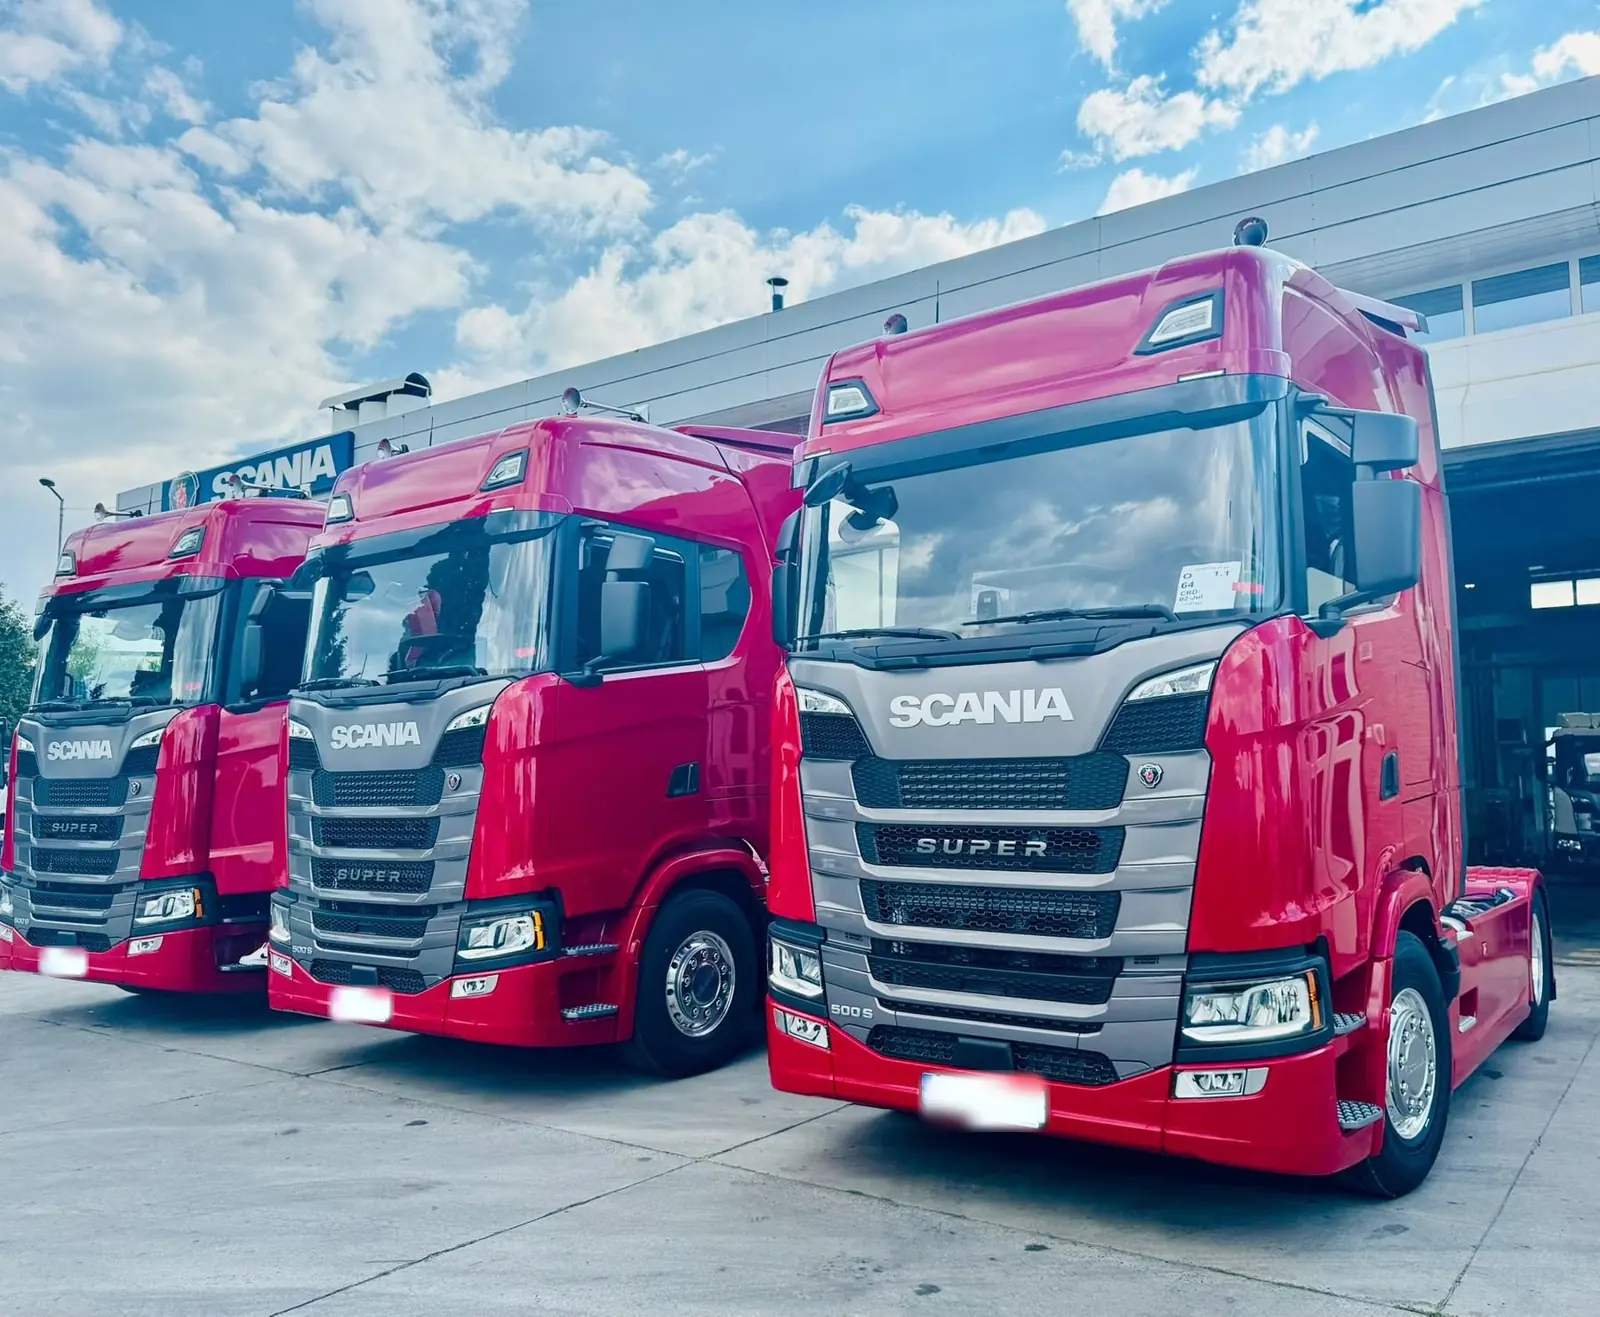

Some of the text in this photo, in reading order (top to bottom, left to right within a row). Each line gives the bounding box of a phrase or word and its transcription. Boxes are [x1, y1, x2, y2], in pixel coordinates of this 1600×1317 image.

[211, 444, 337, 502] SCANIA
[889, 687, 1074, 729] SCANIA
[330, 721, 421, 750] SCANIA
[47, 740, 112, 760] SCANIA
[52, 822, 98, 833] SUPER
[916, 838, 1048, 857] SUPER
[337, 868, 401, 882] SUPER
[292, 945, 313, 955] 500 S
[831, 1004, 873, 1019] 500 S
